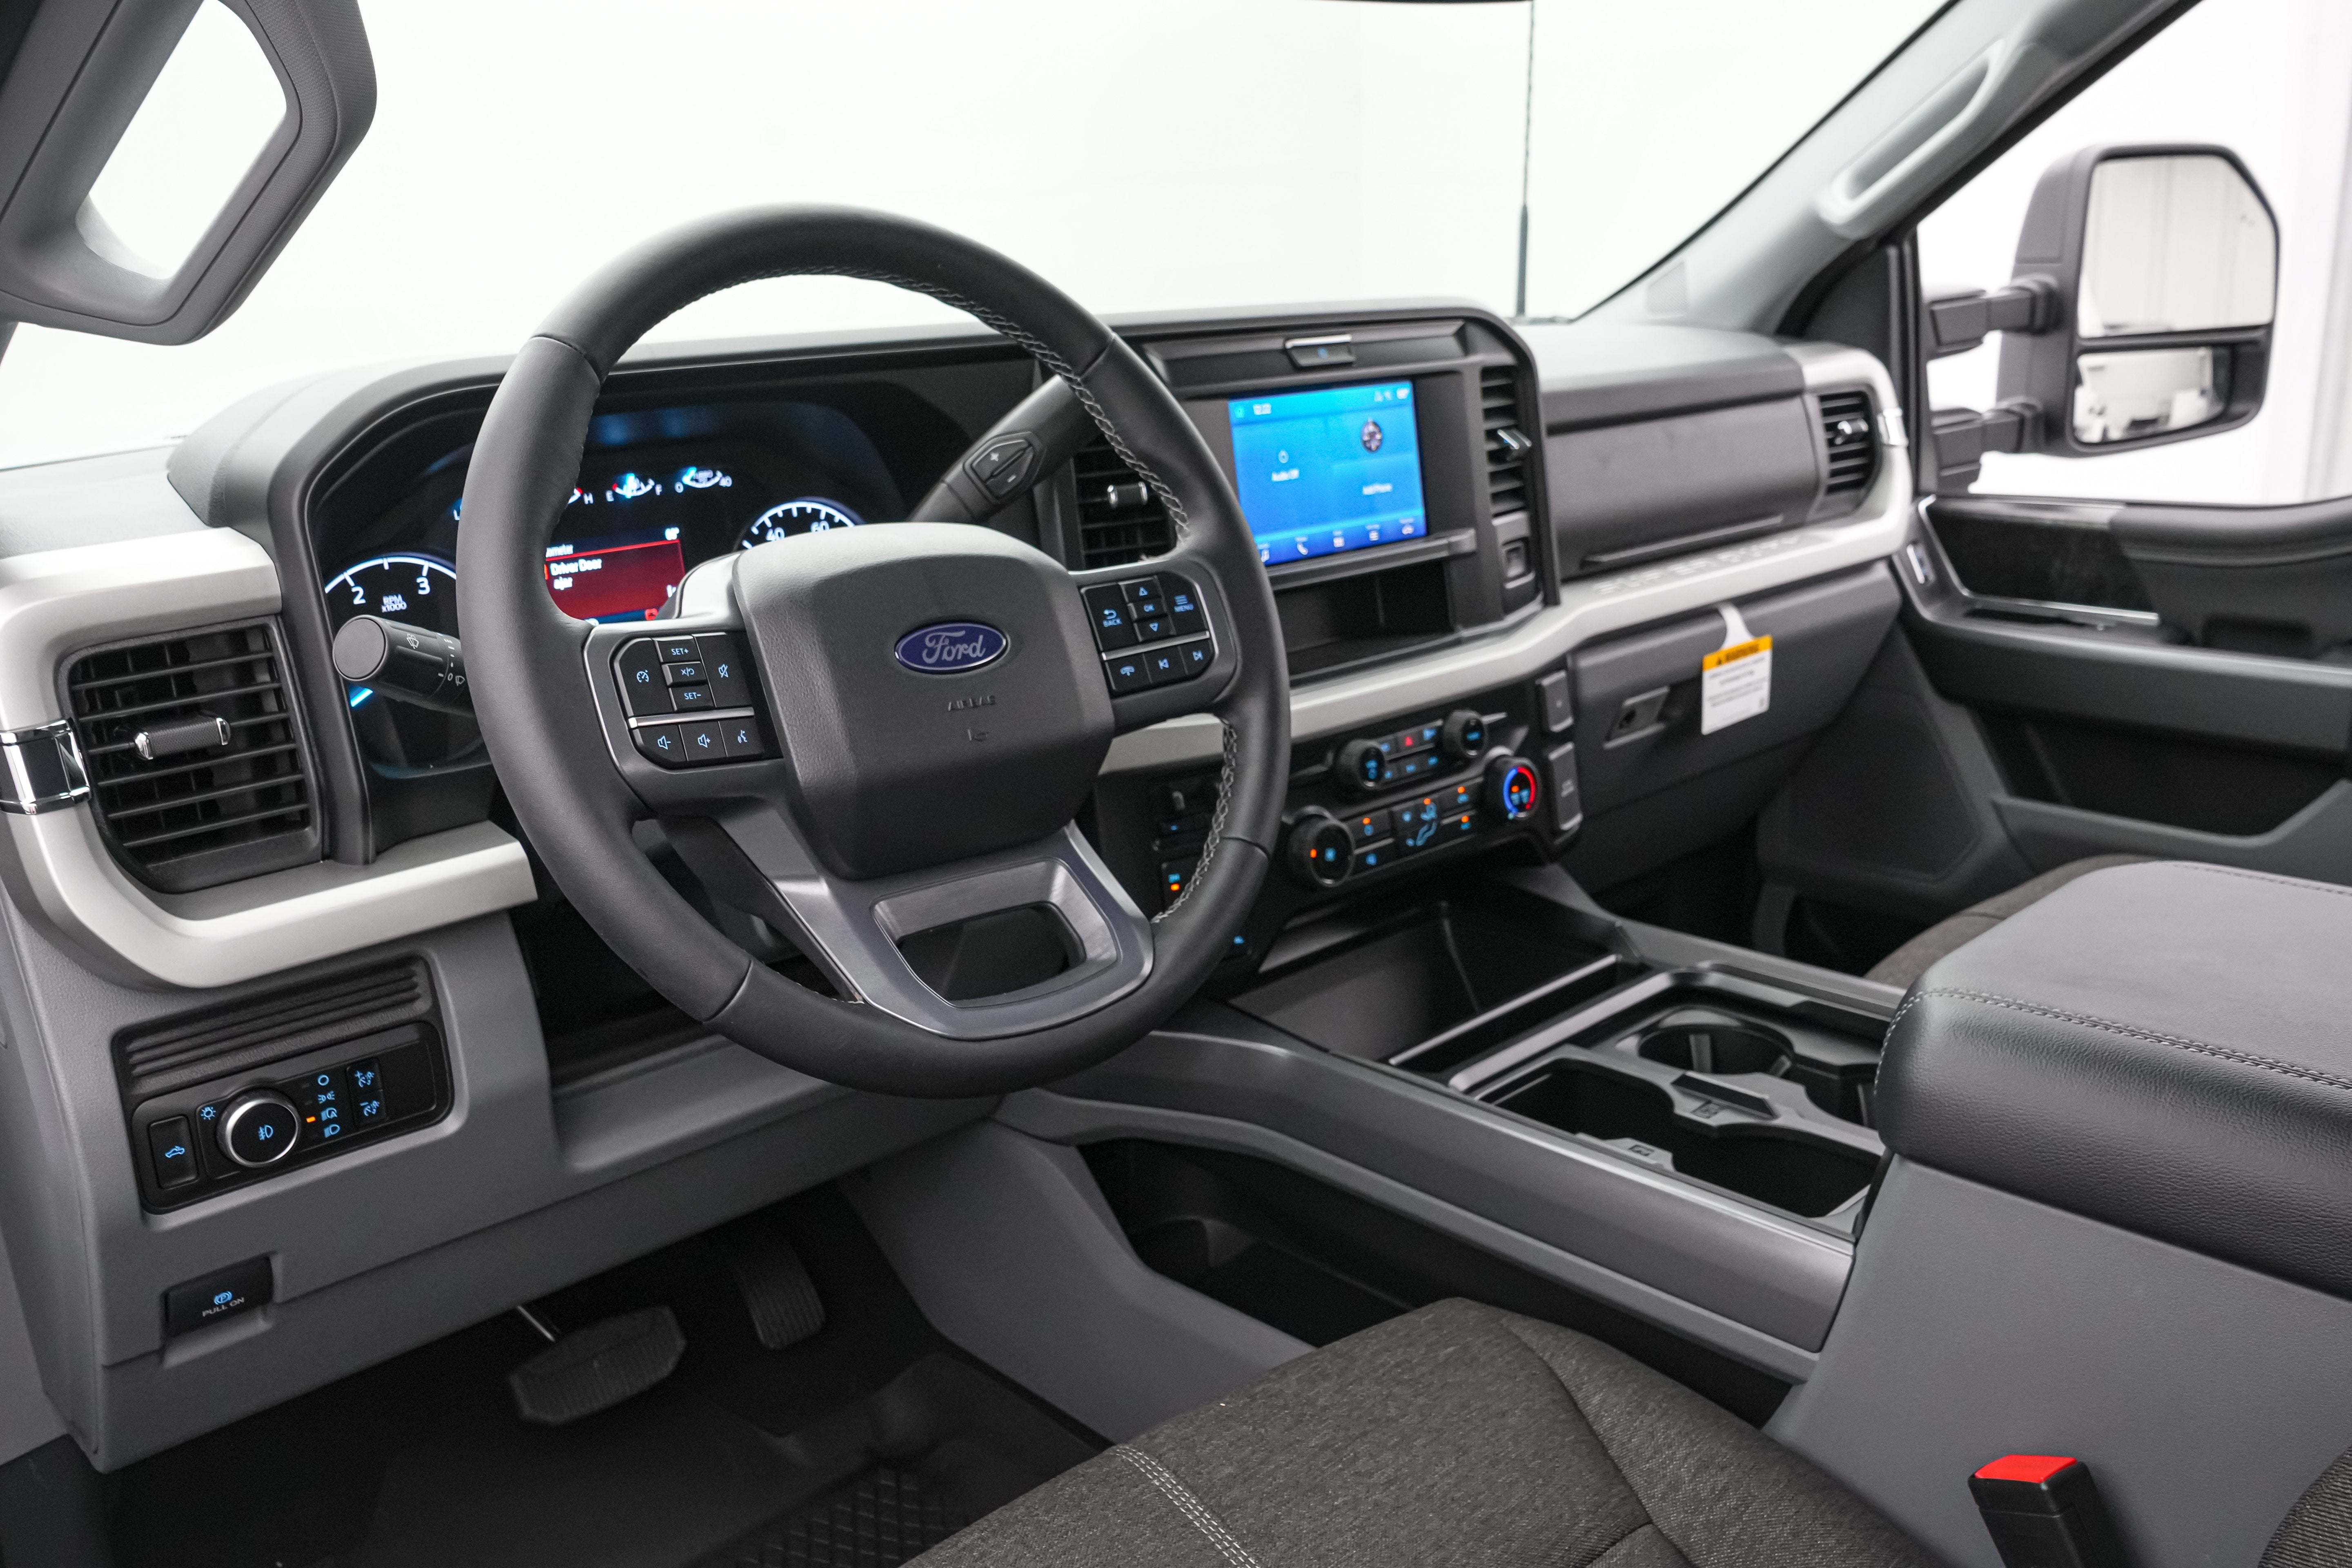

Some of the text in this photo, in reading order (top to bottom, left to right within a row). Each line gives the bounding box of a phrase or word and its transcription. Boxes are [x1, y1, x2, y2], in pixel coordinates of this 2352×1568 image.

[584, 493, 594, 504] H
[606, 484, 662, 502] E F
[766, 527, 785, 541] 40
[811, 521, 829, 532] 60
[550, 559, 602, 576] Driver Door
[416, 577, 430, 595] 3
[351, 586, 366, 605] 2
[383, 594, 403, 604] RPM
[1143, 604, 1155, 612] OK
[1102, 618, 1122, 627] BACK
[922, 630, 986, 664] Ford
[202, 1297, 245, 1317] PULL ON
